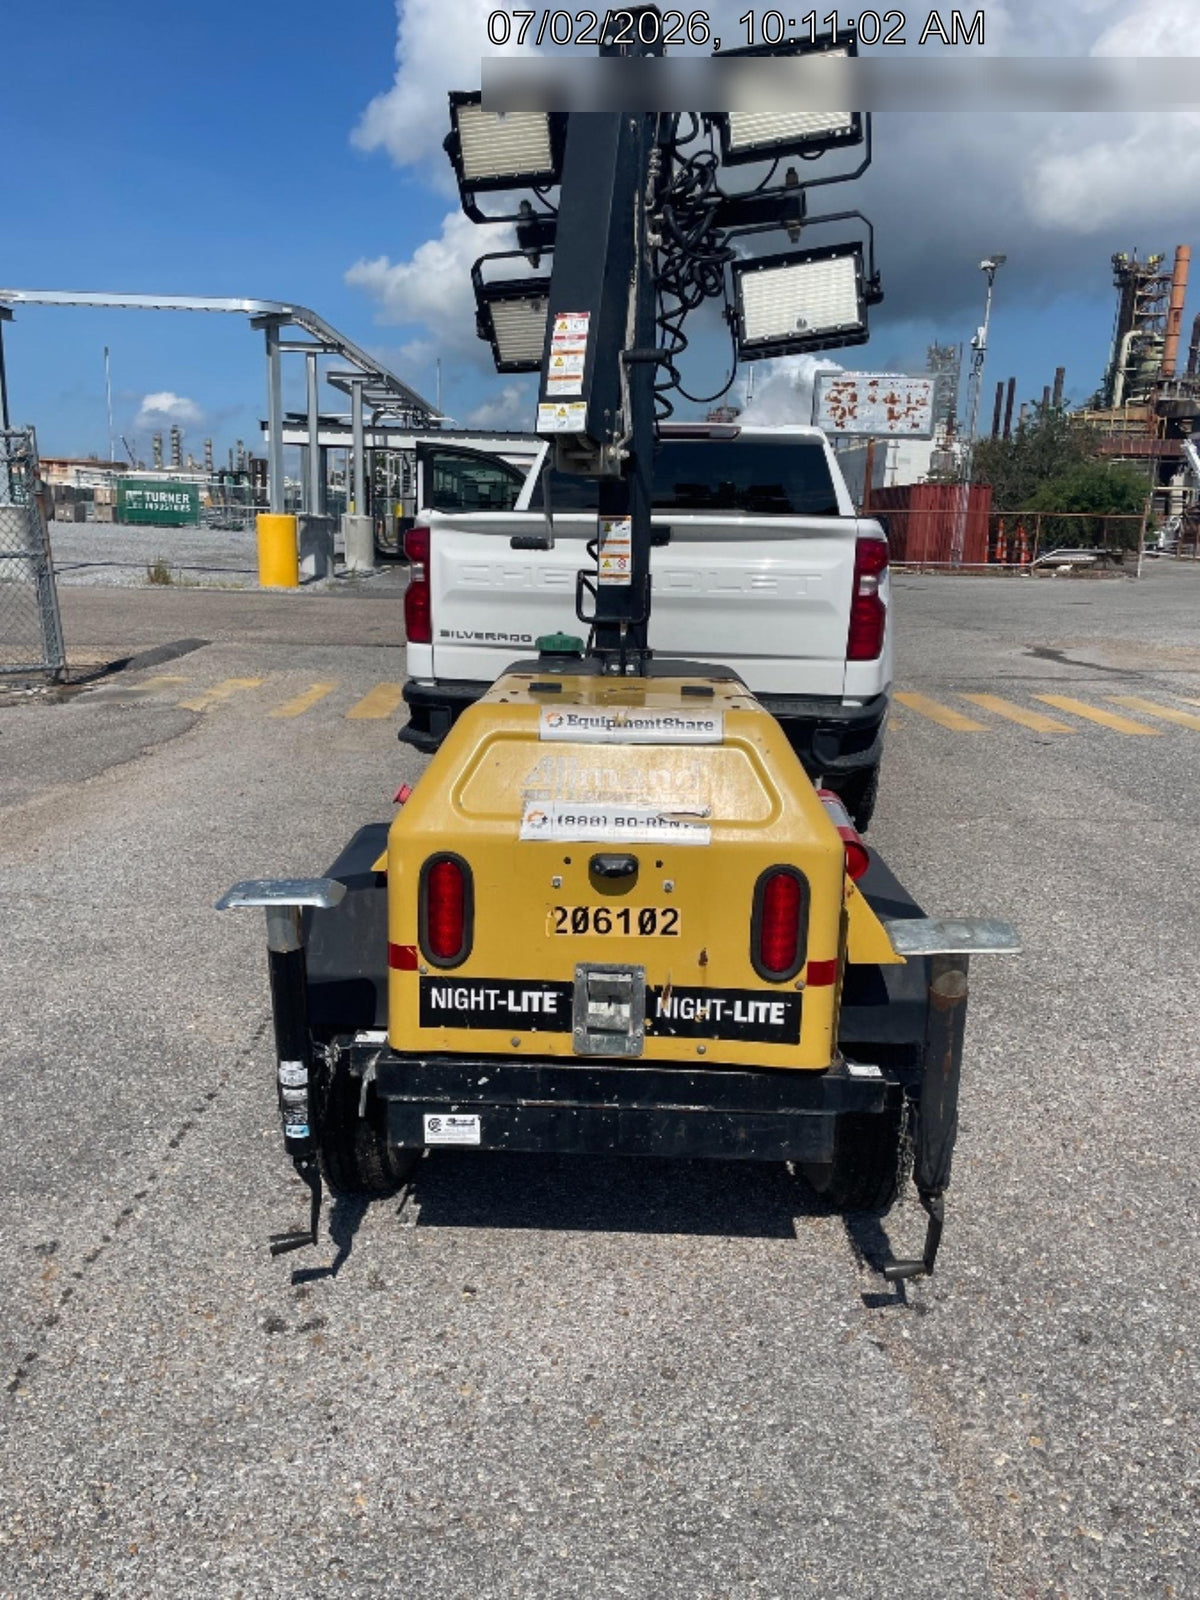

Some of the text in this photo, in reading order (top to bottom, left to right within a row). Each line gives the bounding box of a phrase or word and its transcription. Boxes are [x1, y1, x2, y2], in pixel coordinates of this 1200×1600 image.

[144, 491, 190, 504] TURNER
[440, 629, 532, 643] SILVERADO
[557, 815, 608, 827] (888)
[554, 905, 679, 936] 206102
